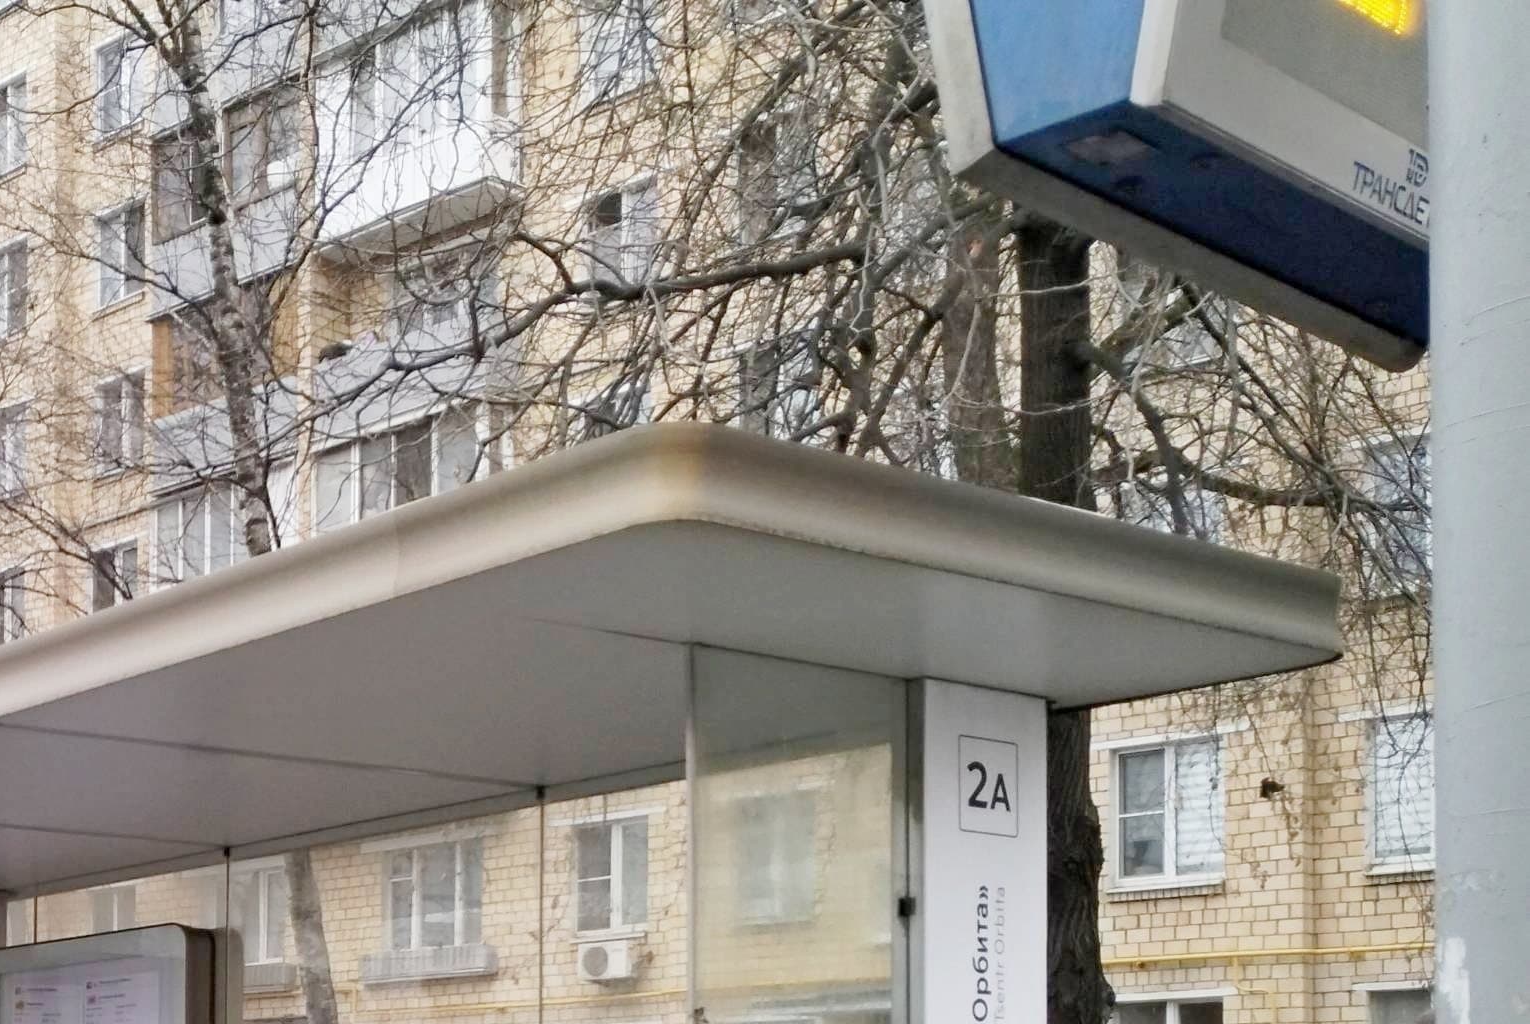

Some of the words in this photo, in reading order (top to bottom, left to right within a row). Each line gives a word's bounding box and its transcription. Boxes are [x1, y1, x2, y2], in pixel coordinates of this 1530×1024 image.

[1352, 160, 1430, 228] ТРАНСДЕ
[967, 761, 1011, 812] 2А
[993, 887, 1007, 956] Orbita
